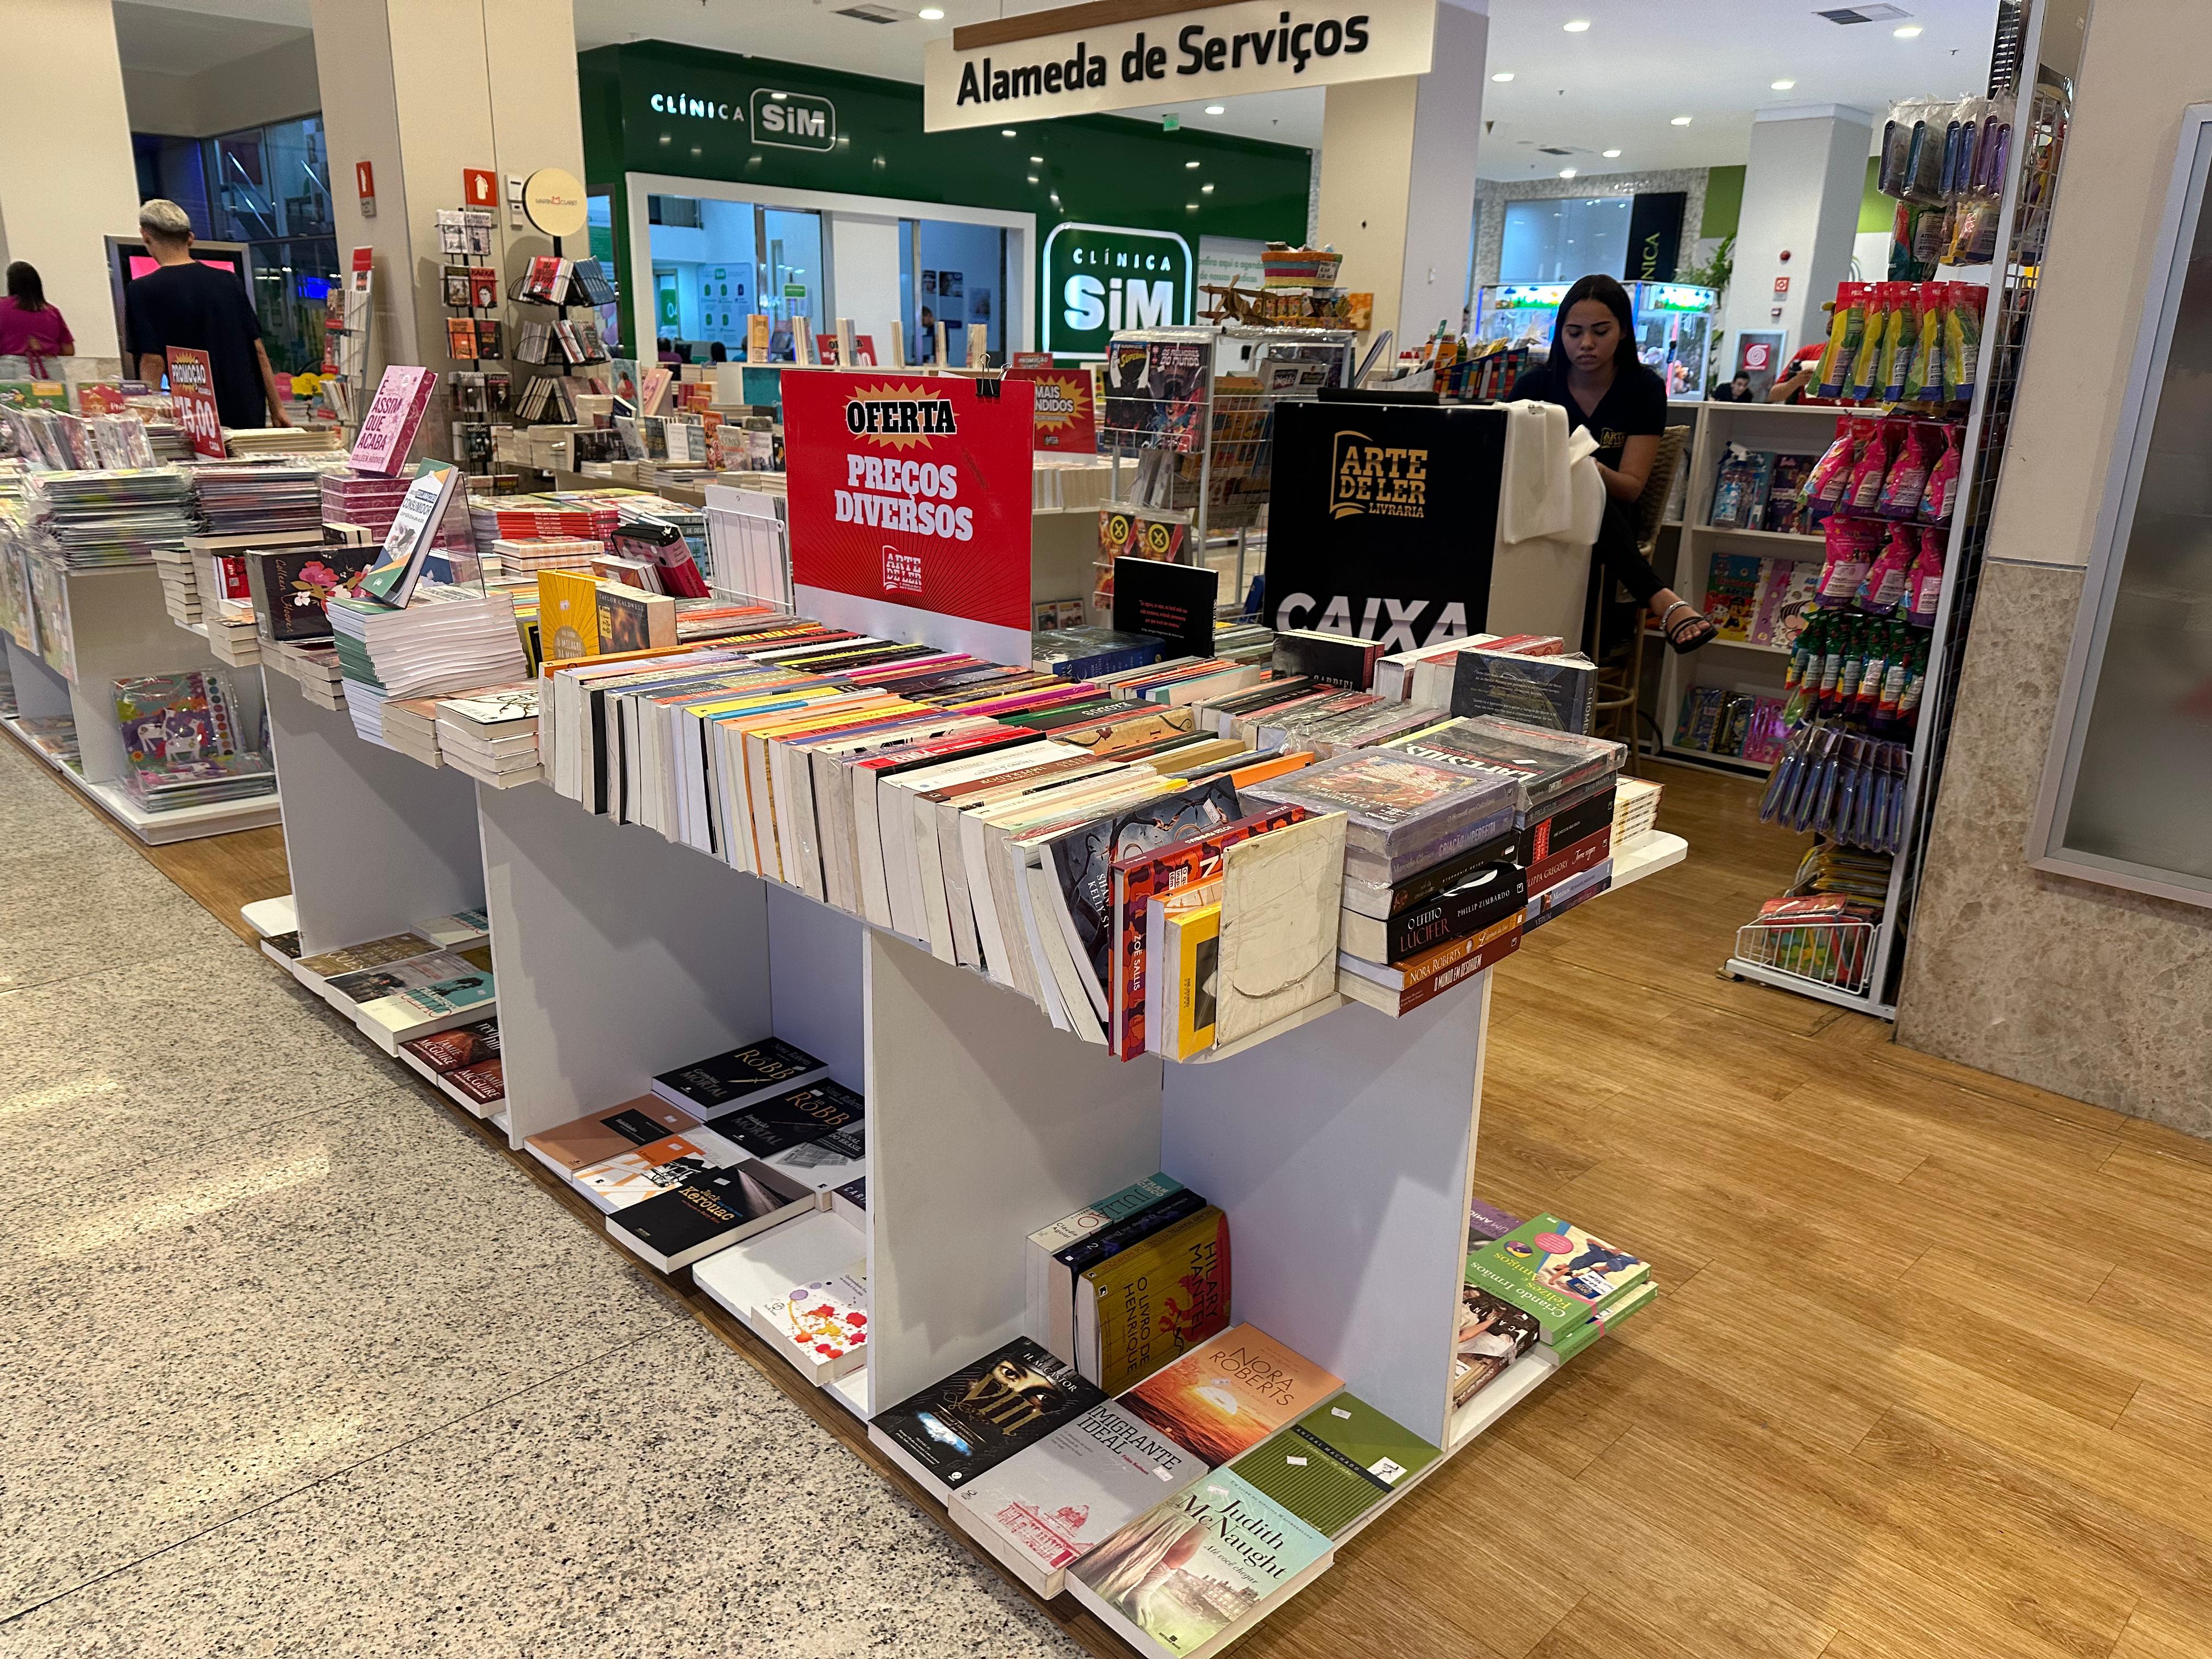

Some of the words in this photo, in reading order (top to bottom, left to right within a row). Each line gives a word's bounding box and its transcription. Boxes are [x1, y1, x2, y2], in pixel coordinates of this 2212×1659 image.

[957, 42, 1106, 106] Alameda
[1121, 32, 1166, 83] de
[1176, 12, 1370, 75] Serviços
[651, 92, 745, 122] CLÍNICA
[1073, 246, 1171, 272] CLÍNICA
[379, 375, 391, 395] É
[1035, 386, 1062, 399] MAIS
[371, 397, 403, 414] ASSIM
[845, 399, 957, 435] OFERTA
[1035, 399, 1075, 413] NDIDOS
[365, 414, 386, 432] QUE
[357, 432, 387, 450] ACABA
[1340, 446, 1428, 479] ARTE
[847, 454, 958, 502] PREÇOS
[1339, 475, 1372, 500] DE
[1375, 479, 1426, 505] LER
[834, 489, 973, 541] DIVERSOS
[1369, 503, 1425, 518] LIVRARIA
[275, 559, 287, 591] Colleen
[886, 552, 922, 573] ARTE
[887, 567, 900, 582] DE
[902, 569, 922, 586] LER
[280, 594, 294, 633] Hoover
[599, 593, 617, 604] TAYLOR
[618, 600, 645, 611] CALDWELL
[1276, 592, 1470, 652] CAIXA
[1438, 834, 1465, 857] CRIAÇÃO
[1527, 873, 1543, 888] LIPPA
[1544, 859, 1569, 878] GREGORY
[1087, 880, 1105, 913] KELLY
[1408, 918, 1415, 930] O
[1417, 907, 1442, 927] EFEITO
[1457, 902, 1478, 918] PHILIP
[1479, 889, 1510, 909] ZIMBARDO
[1133, 934, 1143, 957] ZOË
[1133, 959, 1141, 991] SALLIS
[1409, 965, 1431, 985] NORA
[1432, 947, 1462, 973] ROBERTS
[1434, 977, 1438, 992] O
[1438, 968, 1454, 990] MUNDO
[1453, 965, 1460, 981] EM
[416, 1039, 458, 1065] MCGUIRE
[438, 1039, 464, 1056] JAMIE
[772, 1043, 790, 1054] Nora
[734, 1049, 795, 1079] ROBB
[458, 1069, 501, 1098] MCGUIRE
[785, 1091, 850, 1125] ROBB
[835, 1129, 860, 1145] JORNAL
[838, 1136, 863, 1152] BRASIL
[700, 1189, 722, 1202] Jack
[1136, 1181, 1165, 1198] CISCO
[1143, 1177, 1169, 1194] FRAN
[678, 1186, 735, 1220] Kerouac
[1053, 1227, 1072, 1239] Aguiar
[1057, 1222, 1079, 1237] Cláudio
[1492, 1222, 1509, 1233] UM
[1086, 1243, 1099, 1251] 2
[1203, 1240, 1218, 1317] HILARY
[1470, 1261, 1515, 1290] Irmãos
[1492, 1252, 1544, 1282] Amigos
[1137, 1276, 1148, 1290] O
[1188, 1242, 1207, 1338] MANTEL
[1526, 1281, 1572, 1309] Felizes
[1138, 1294, 1151, 1340] LIVRO
[1515, 1288, 1566, 1317] Criando
[1122, 1282, 1137, 1374] HENRIQUE
[1139, 1342, 1150, 1366] DE
[1023, 1352, 1033, 1362] H.
[1032, 1359, 1043, 1370] M.
[1043, 1366, 1078, 1394] CASTOR
[1209, 1351, 1294, 1406] ROBERTS
[1229, 1347, 1294, 1391] NORA
[1076, 1416, 1128, 1455] IDEAL
[1087, 1405, 1183, 1470] IMIGRANTE
[1295, 1427, 1324, 1448] ANÍBAL
[1324, 1447, 1360, 1472] MACHADO
[1306, 1444, 1331, 1462] Cadernos
[1175, 1492, 1287, 1579] McNaught
[1217, 1498, 1284, 1551] Judith
[1203, 1544, 1220, 1558] Até
[1218, 1553, 1235, 1567] você
[1233, 1564, 1259, 1585] chegar
